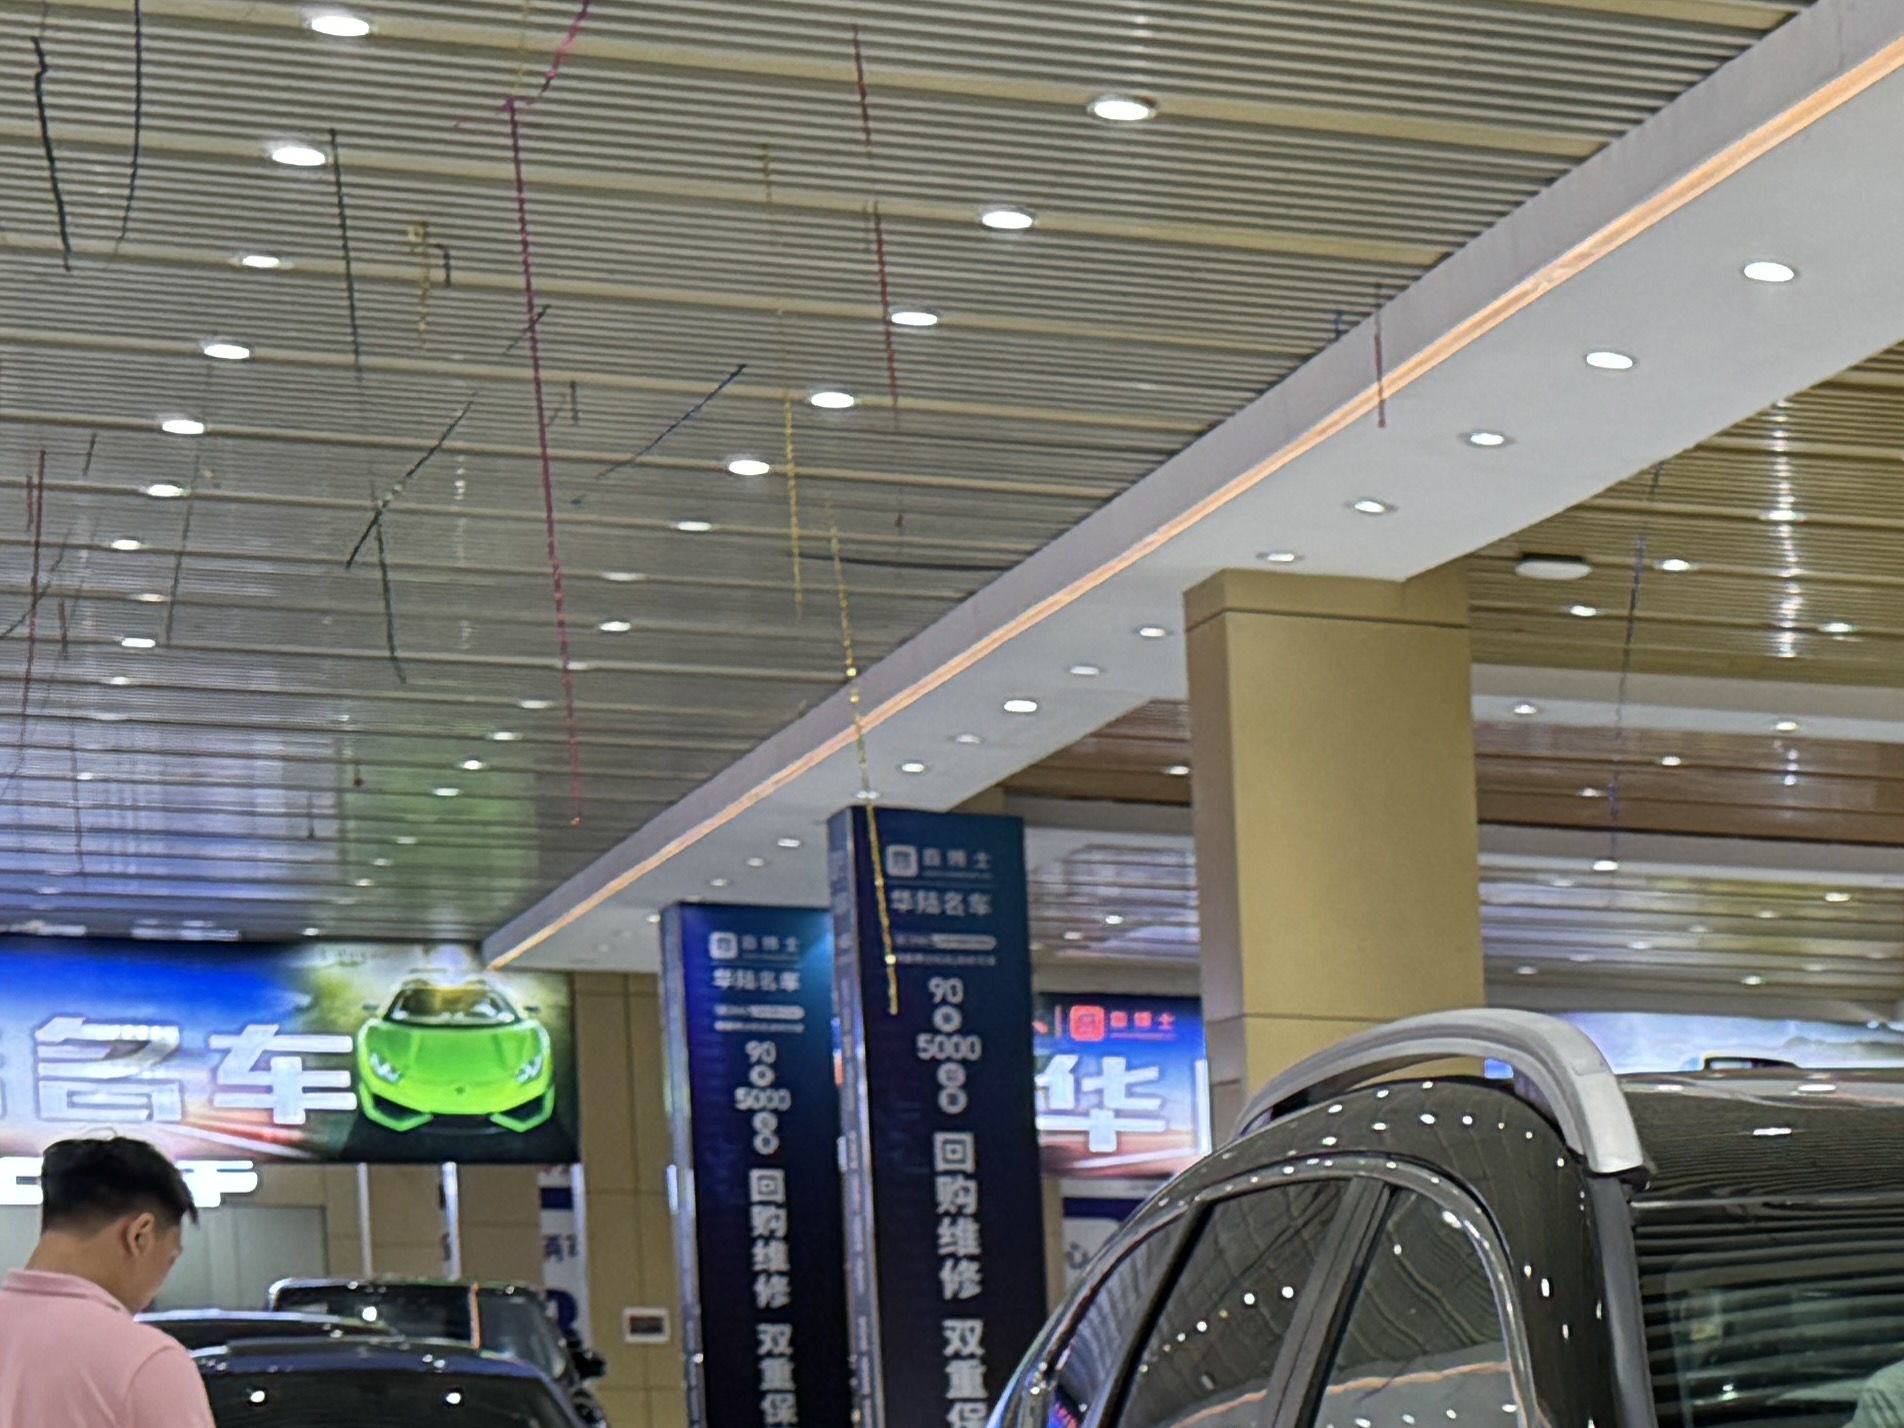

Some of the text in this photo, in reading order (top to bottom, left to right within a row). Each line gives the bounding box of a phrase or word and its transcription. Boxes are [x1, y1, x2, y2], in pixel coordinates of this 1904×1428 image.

[928, 976, 964, 1004] 90
[0, 1016, 358, 1125] 名车
[745, 1041, 776, 1064] 90
[916, 1033, 982, 1061] 5000
[734, 1087, 792, 1111] 5000
[1035, 1053, 1211, 1155] 华
[748, 1168, 792, 1309] 回购维修
[934, 1131, 983, 1300] 回购维修
